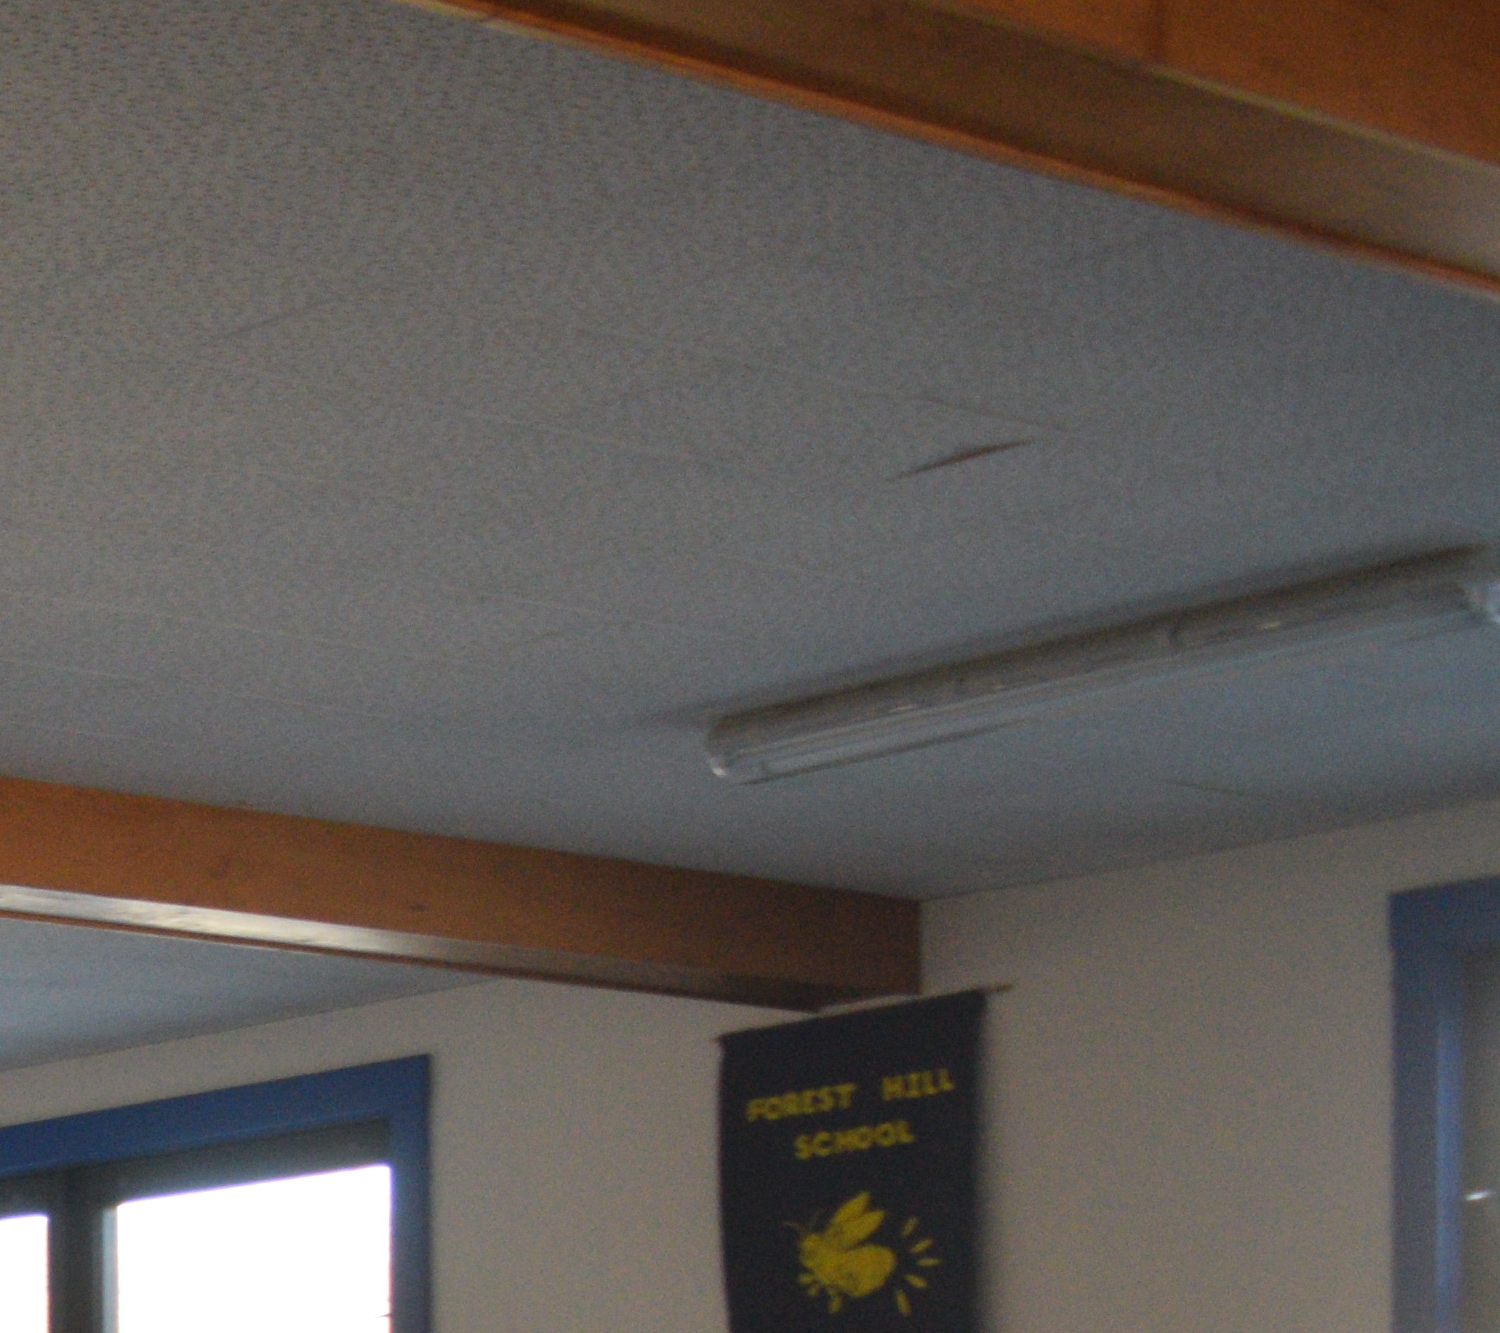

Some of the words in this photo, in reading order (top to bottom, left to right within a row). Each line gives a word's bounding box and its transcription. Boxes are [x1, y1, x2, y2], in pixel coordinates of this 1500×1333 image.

[747, 1083, 857, 1122] FOREST
[882, 1068, 955, 1100] HILL
[795, 1119, 914, 1160] SCHOOL
